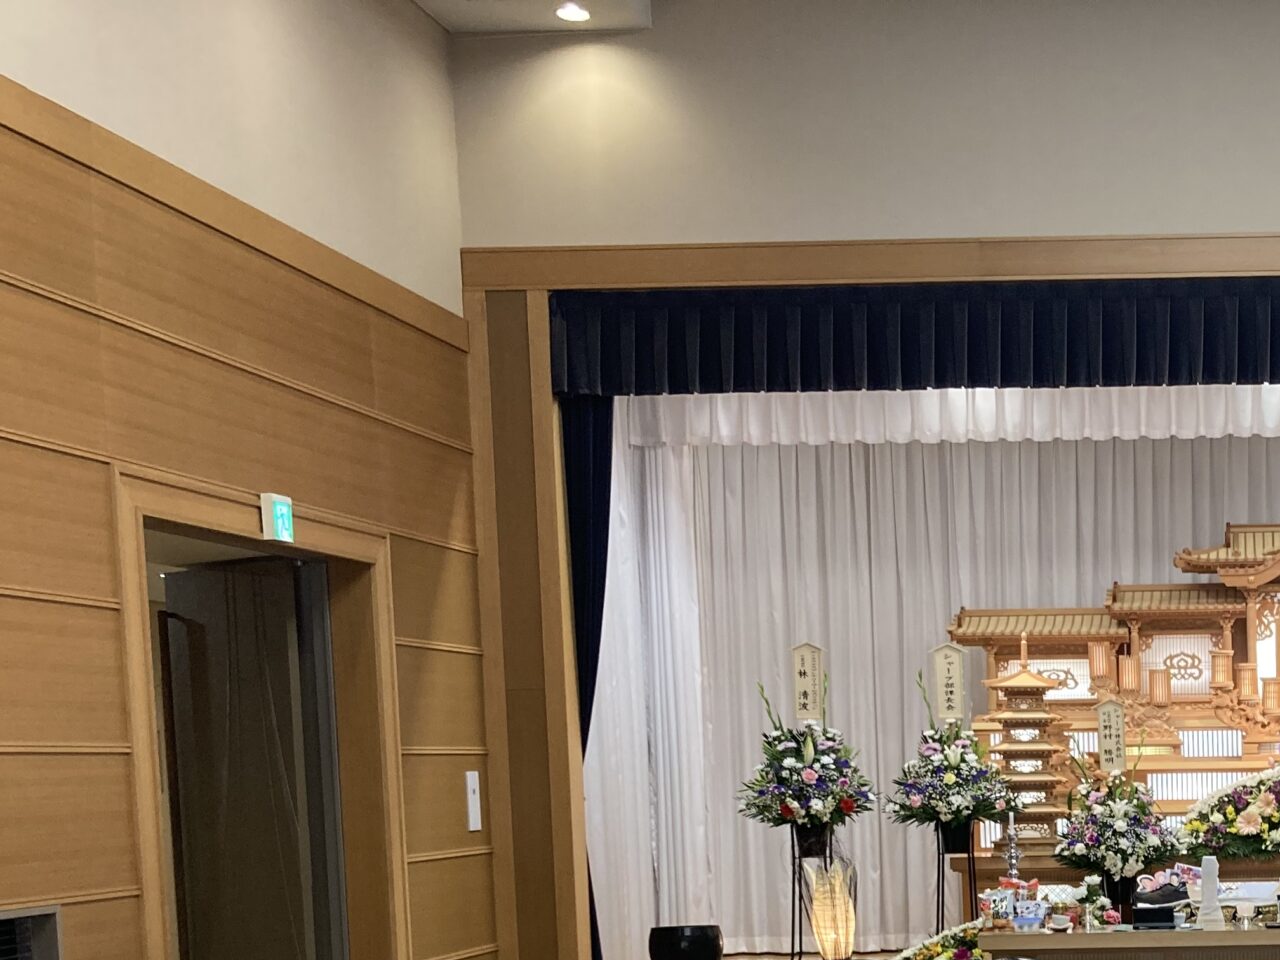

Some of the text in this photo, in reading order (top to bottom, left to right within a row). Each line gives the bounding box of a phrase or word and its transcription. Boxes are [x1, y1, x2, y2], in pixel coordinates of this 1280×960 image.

[1114, 708, 1122, 758] シャープ株式会社
